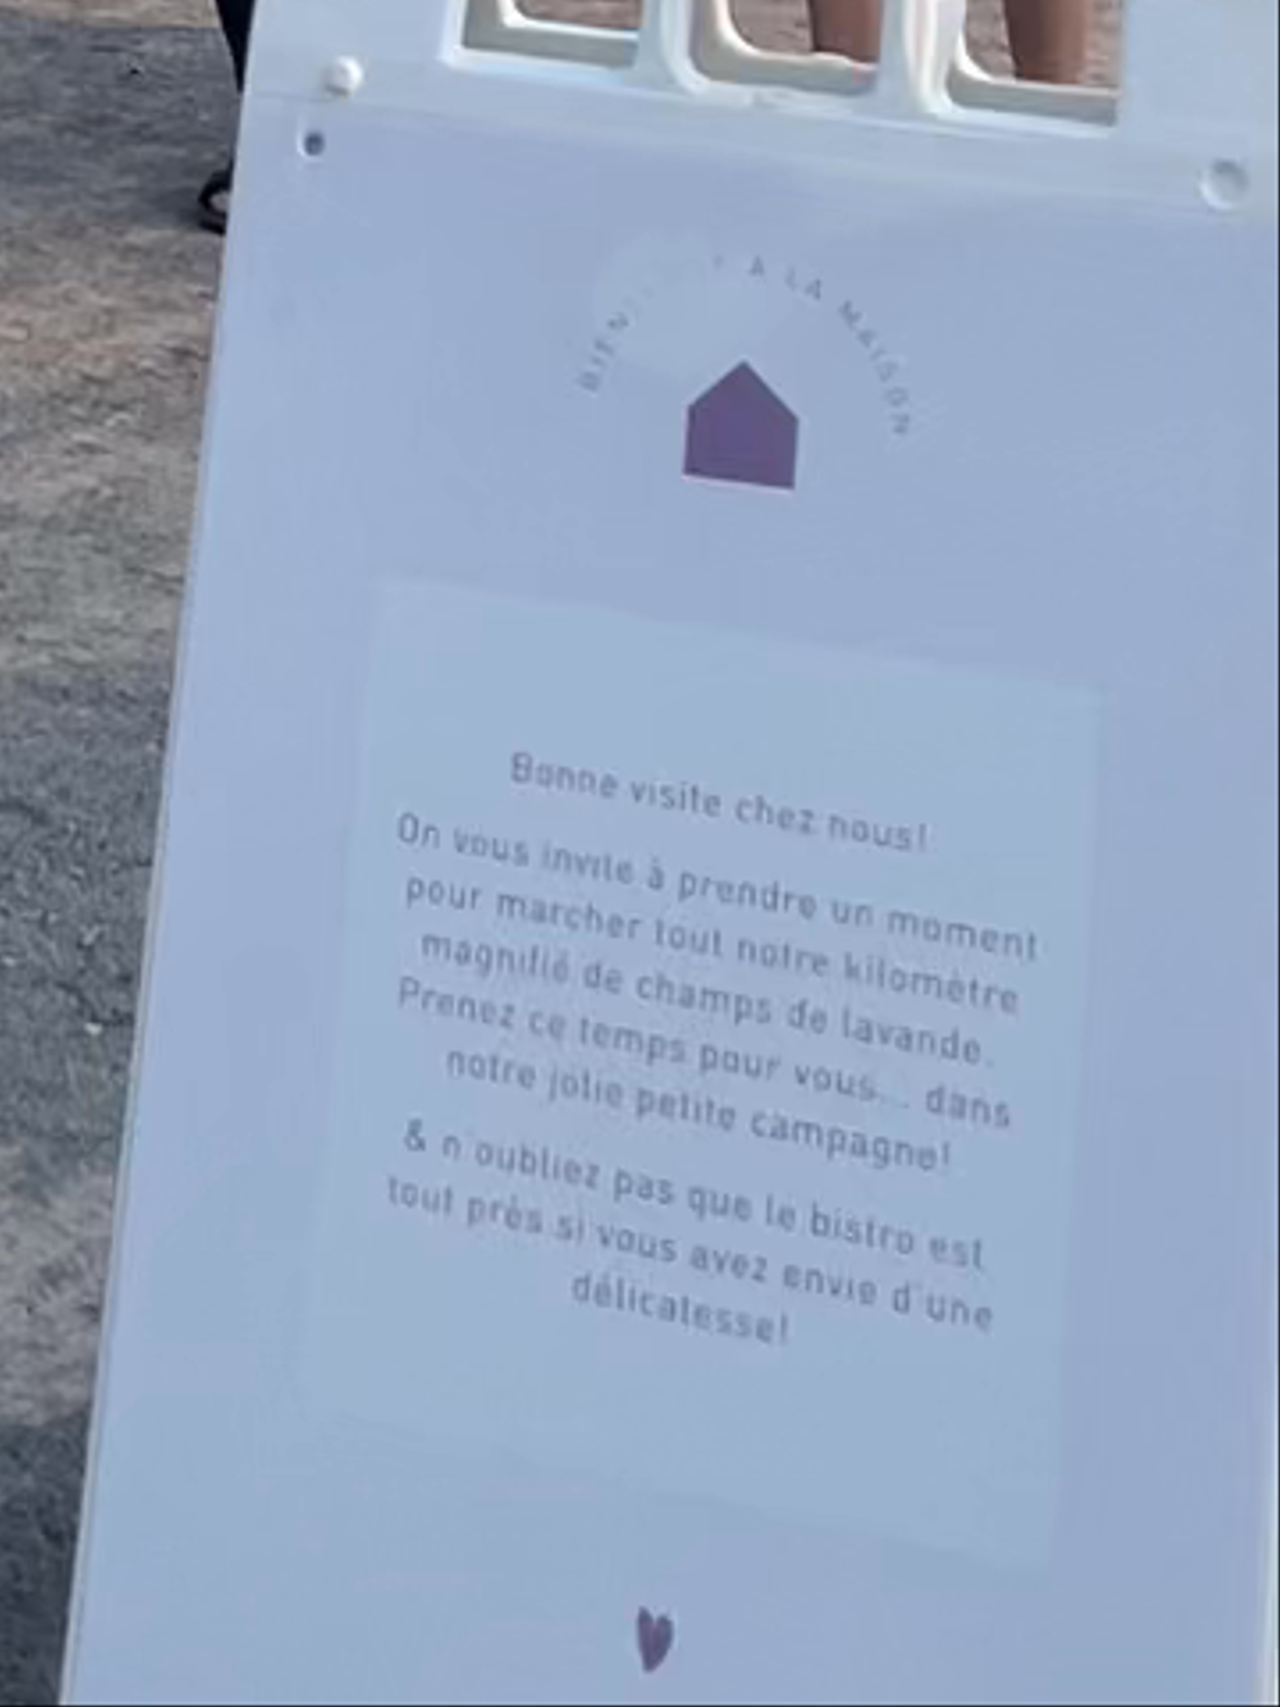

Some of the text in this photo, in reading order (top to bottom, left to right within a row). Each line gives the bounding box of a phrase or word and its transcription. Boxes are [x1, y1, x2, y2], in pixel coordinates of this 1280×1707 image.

[510, 751, 618, 798] Bonne
[630, 779, 722, 818] visite
[735, 795, 815, 834] chez
[398, 812, 1037, 961] On vous invite à prendre un moment
[407, 876, 481, 910] pour
[496, 892, 641, 940] marcher
[655, 919, 722, 958] tout
[737, 937, 829, 976] notre
[399, 976, 515, 1030] Prenez
[529, 1009, 566, 1041] ce
[580, 1018, 686, 1065] temps
[699, 1043, 781, 1082] pour
[925, 1085, 1010, 1129] dans
[583, 960, 623, 994] de
[635, 973, 771, 1025] champs
[787, 997, 828, 1035] de
[447, 1050, 537, 1091] notre
[548, 1067, 623, 1110] jolie
[636, 1087, 736, 1130] petite
[388, 1176, 453, 1214] tout
[467, 1193, 542, 1233] près
[556, 1215, 584, 1243] si
[596, 1223, 677, 1263] vous
[690, 1245, 768, 1282] avez
[783, 1264, 877, 1305] envie
[404, 1118, 426, 1153] &
[613, 1168, 675, 1205] pas
[687, 1185, 752, 1222] que
[766, 1193, 796, 1232] le
[809, 1202, 915, 1255] bistro
[929, 1237, 983, 1270] est
